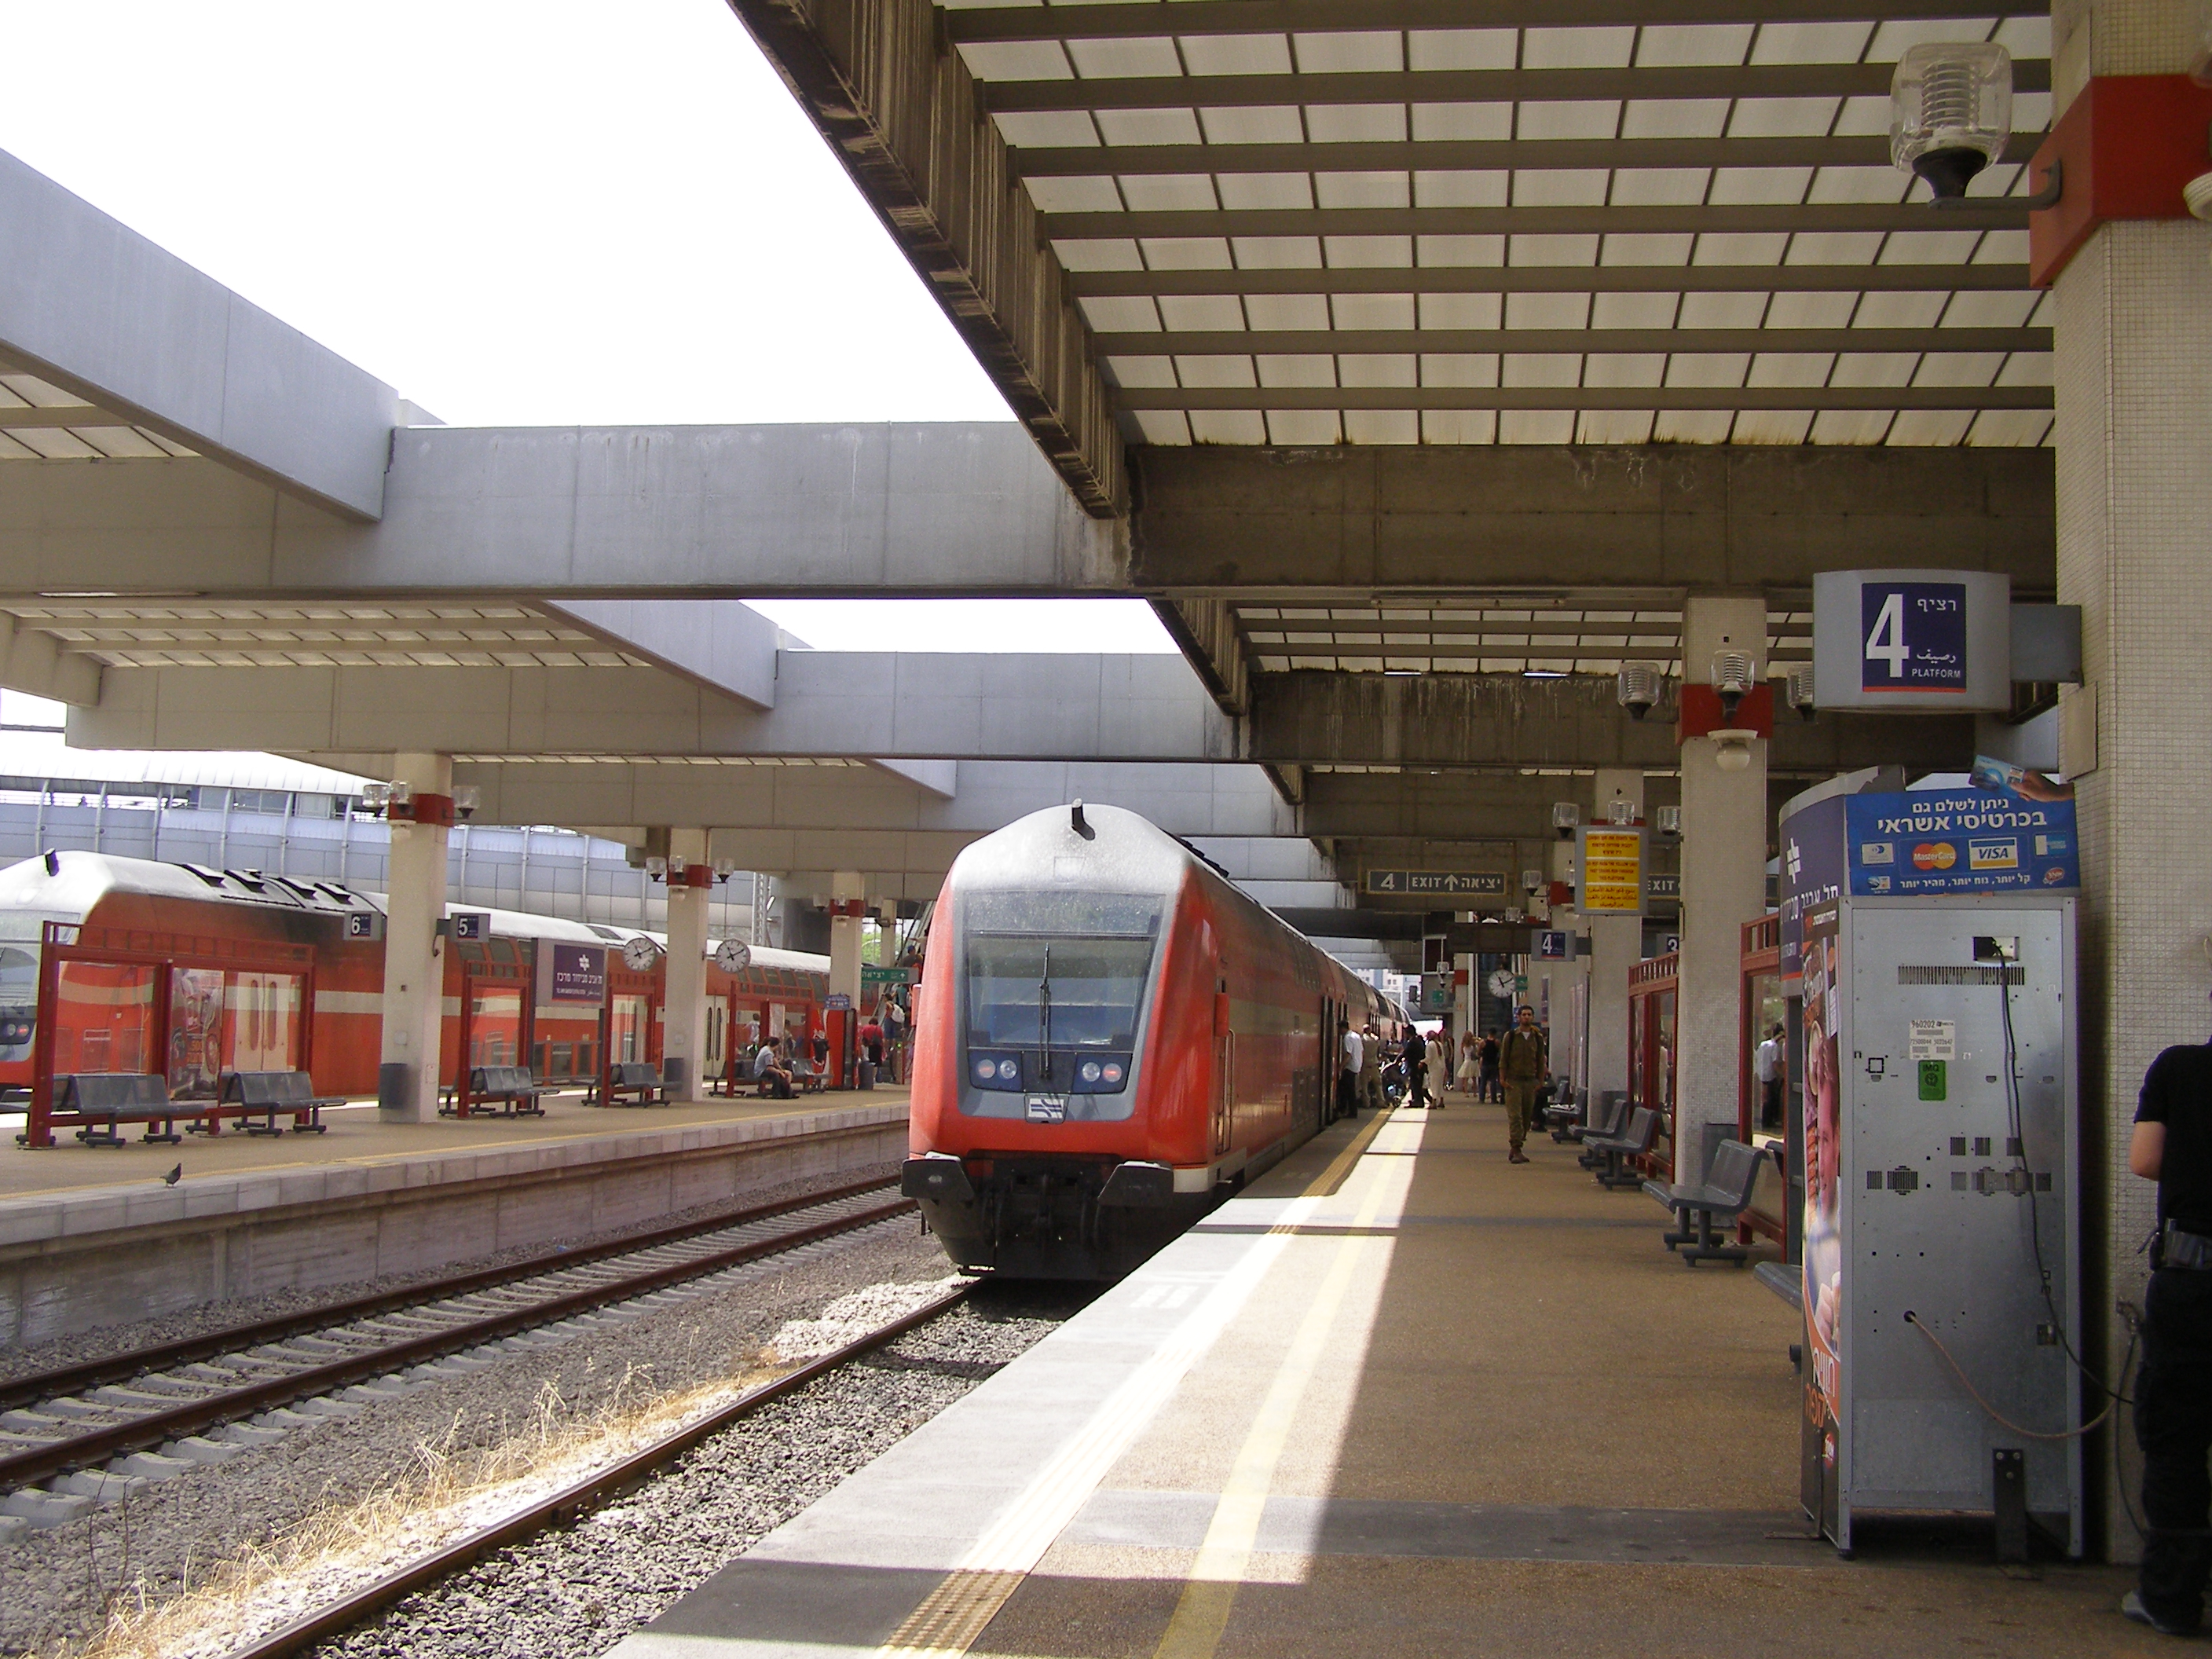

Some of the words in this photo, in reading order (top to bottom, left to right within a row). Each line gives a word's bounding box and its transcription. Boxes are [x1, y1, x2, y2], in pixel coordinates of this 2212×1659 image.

[1917, 598, 1957, 613] רציף
[1866, 593, 1910, 678] 4
[1917, 649, 1957, 665] رصيف
[1911, 668, 1961, 679] PLATFORM
[1912, 802, 1931, 814] גם
[1935, 797, 1976, 812] לשלם
[1980, 798, 2009, 811] ניתן
[1877, 815, 1951, 834] אשראי
[1956, 811, 2047, 830] בכרטיסי
[1913, 851, 1956, 862] MasterCard
[1978, 847, 2009, 859] VISA
[1380, 873, 1395, 890] 4
[1412, 877, 1441, 888] EXIT
[1461, 877, 1500, 888] יציאה
[1899, 880, 1920, 888] יותר
[2017, 873, 2031, 884] קל
[351, 916, 361, 935] 6
[458, 917, 468, 936] 5
[1542, 933, 1553, 954] 4
